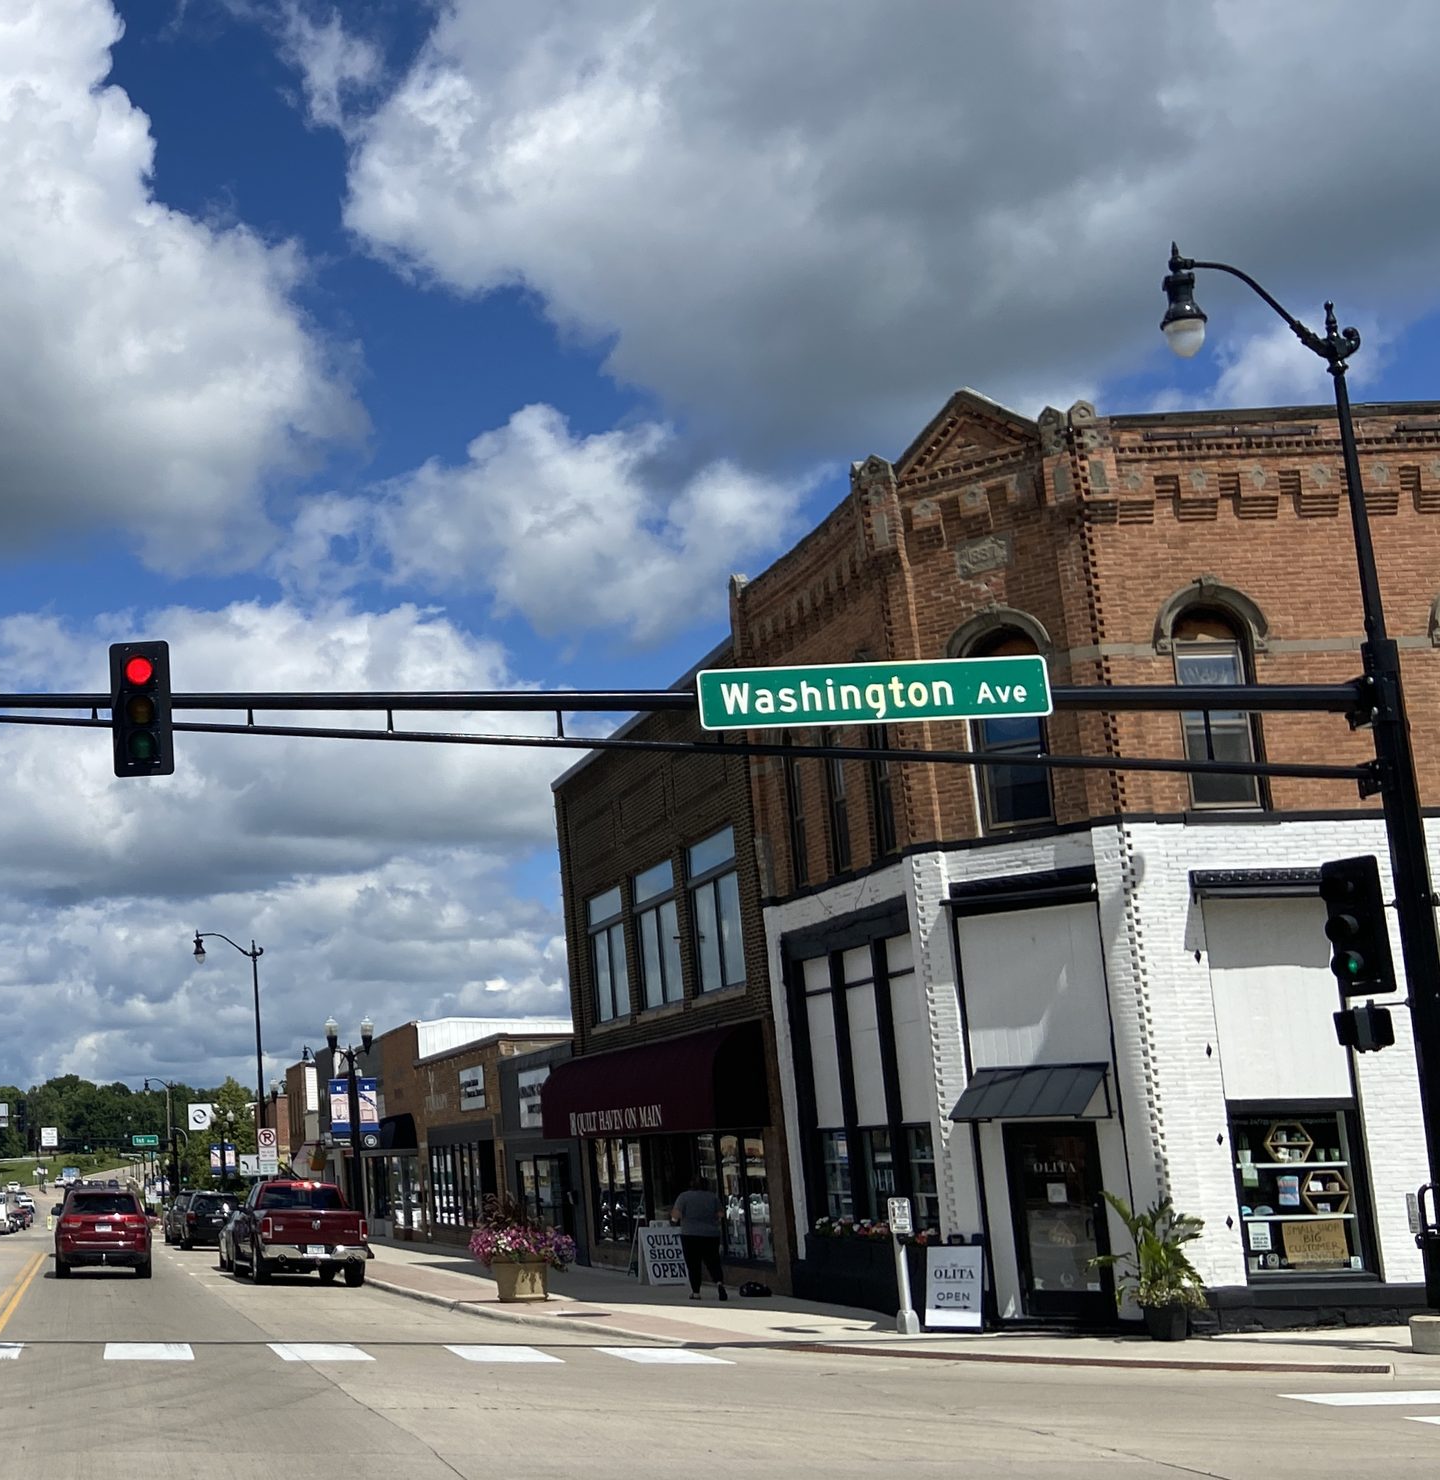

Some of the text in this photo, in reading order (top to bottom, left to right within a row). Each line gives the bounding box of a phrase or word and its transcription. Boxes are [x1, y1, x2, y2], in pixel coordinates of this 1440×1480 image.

[720, 676, 1028, 719] Washington Ave
[576, 1104, 663, 1137] QUILT HAVEN ON MAIN
[1033, 1161, 1077, 1173] OLITA
[1287, 1222, 1340, 1236] SMALL SHOP
[647, 1234, 680, 1248] QUILT
[1303, 1231, 1323, 1243] BIG
[650, 1248, 682, 1260] SHOP
[1288, 1240, 1341, 1254] CUSTOMER
[652, 1262, 687, 1278] OPEN
[934, 1268, 975, 1280] OLITA
[936, 1292, 971, 1302] OPEN
